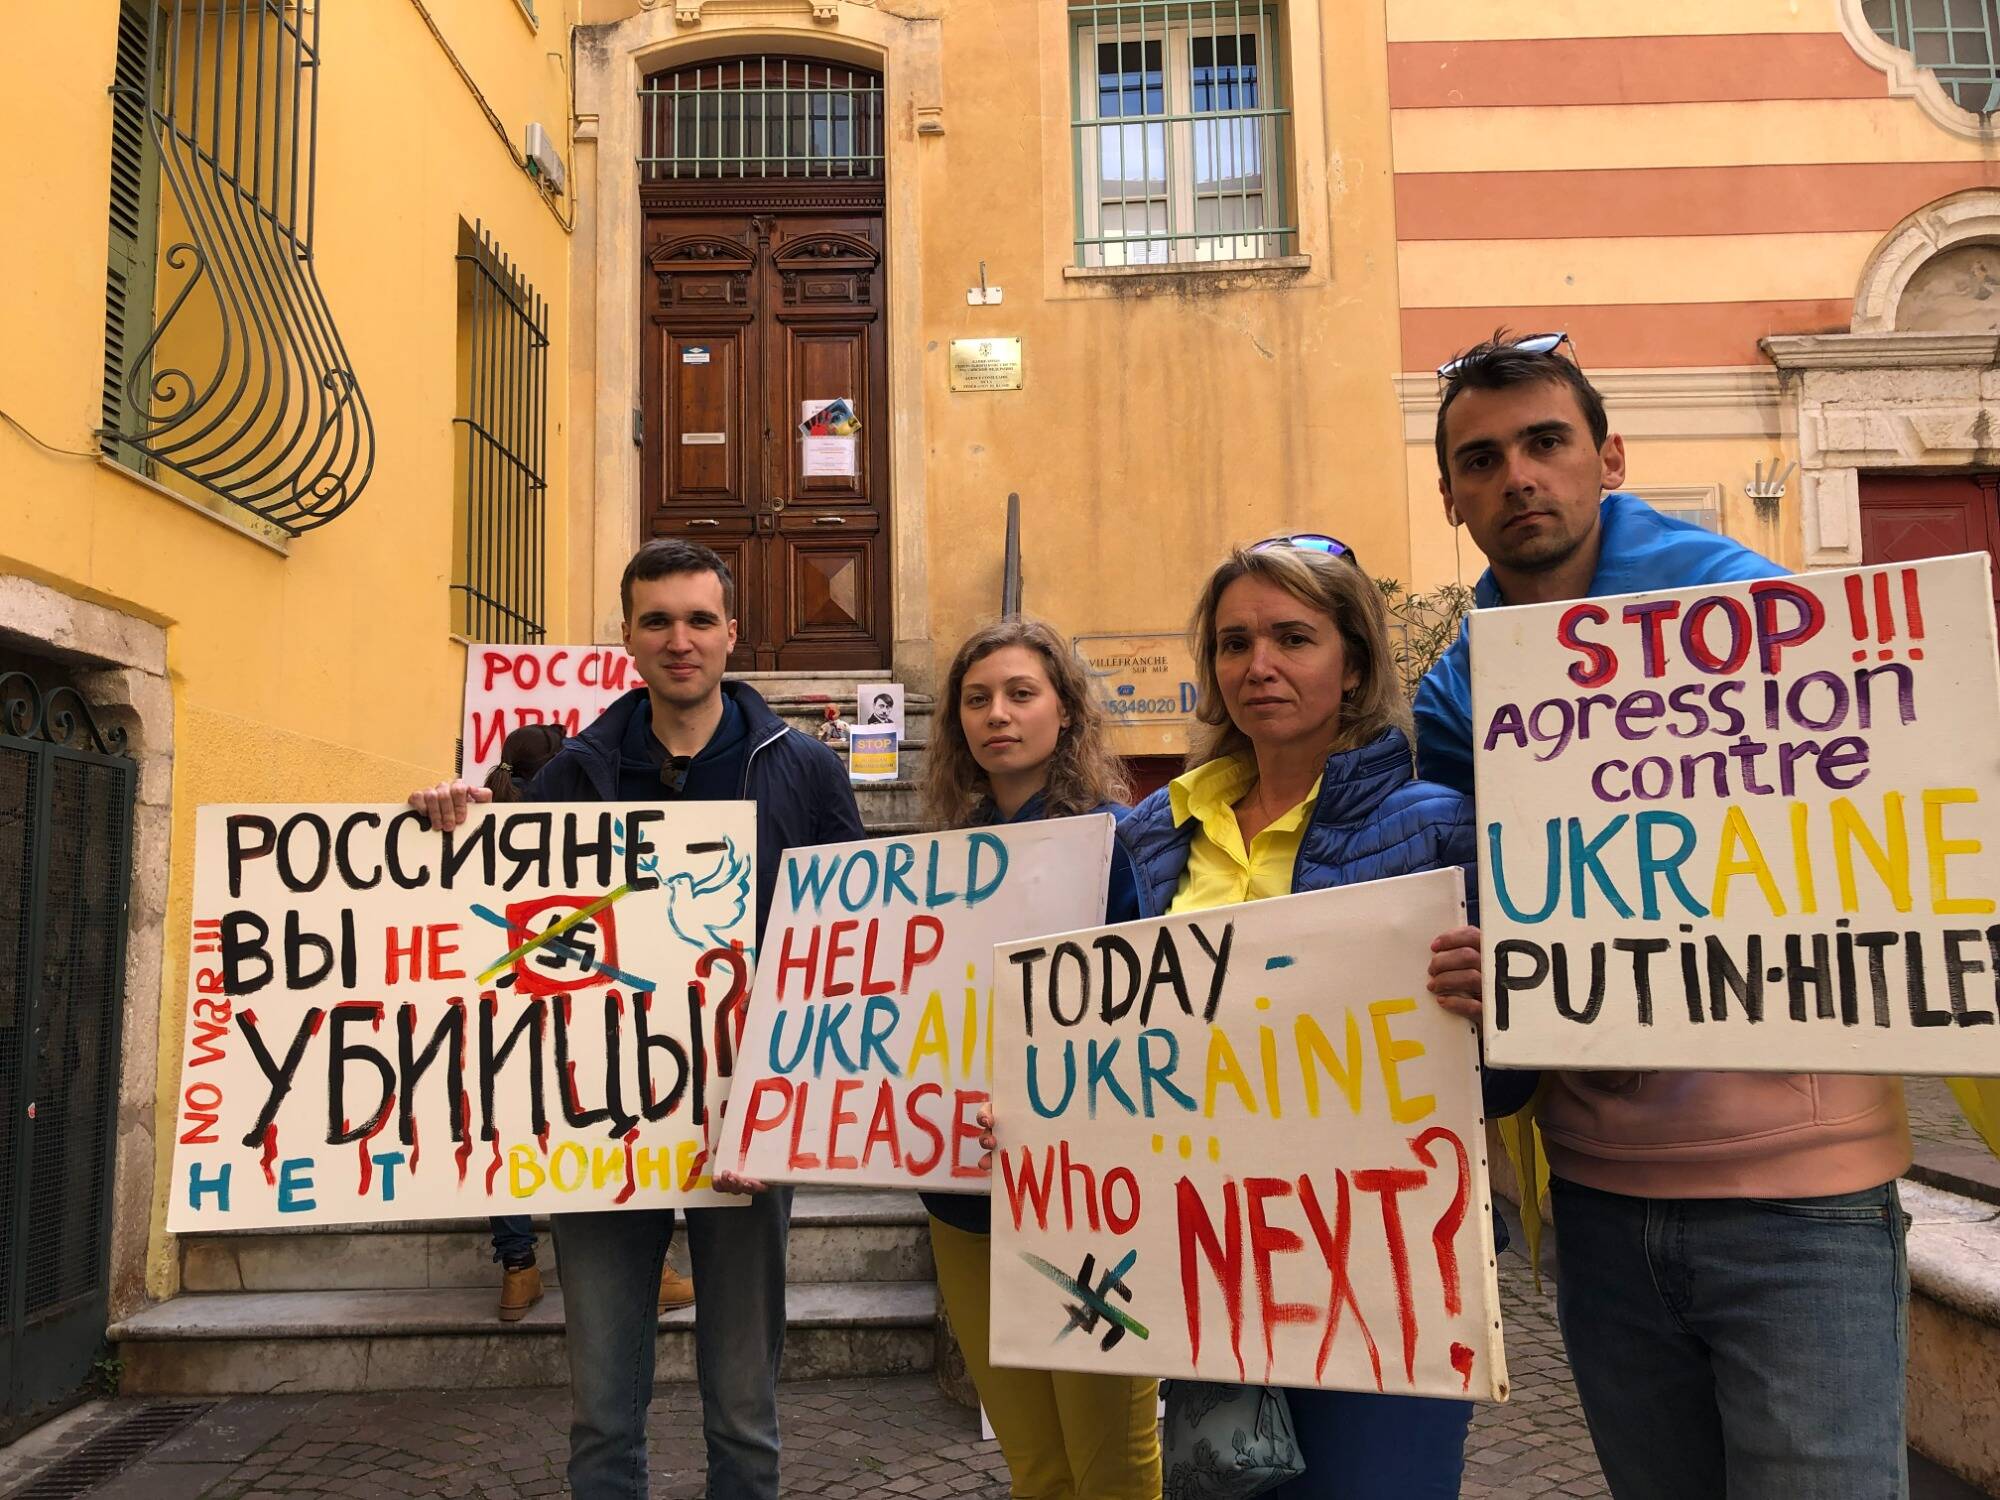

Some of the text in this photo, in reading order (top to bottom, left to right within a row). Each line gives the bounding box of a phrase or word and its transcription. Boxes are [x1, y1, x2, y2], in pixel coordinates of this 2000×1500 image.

[484, 651, 648, 691] РОССИ
[1089, 655, 1169, 667] VILLEFRANCHE
[1132, 665, 1169, 674] SUR MER
[1557, 580, 1825, 688] STOP
[856, 737, 892, 750] STOP
[1591, 734, 1871, 802] contre
[226, 809, 665, 899] РОССИЯНЕ
[786, 831, 1010, 914] WORLD
[1487, 787, 1997, 924] UKRAINE
[222, 907, 467, 997] ВЫ НЕ
[775, 914, 945, 1001] HELP
[1009, 916, 1236, 1037] TODAY
[768, 961, 993, 1089] UKRAi
[180, 1082, 223, 1145] NO
[738, 1076, 992, 1180] PLEASE
[1000, 1139, 1142, 1236] Who
[1174, 1125, 1471, 1393] NEXT?
